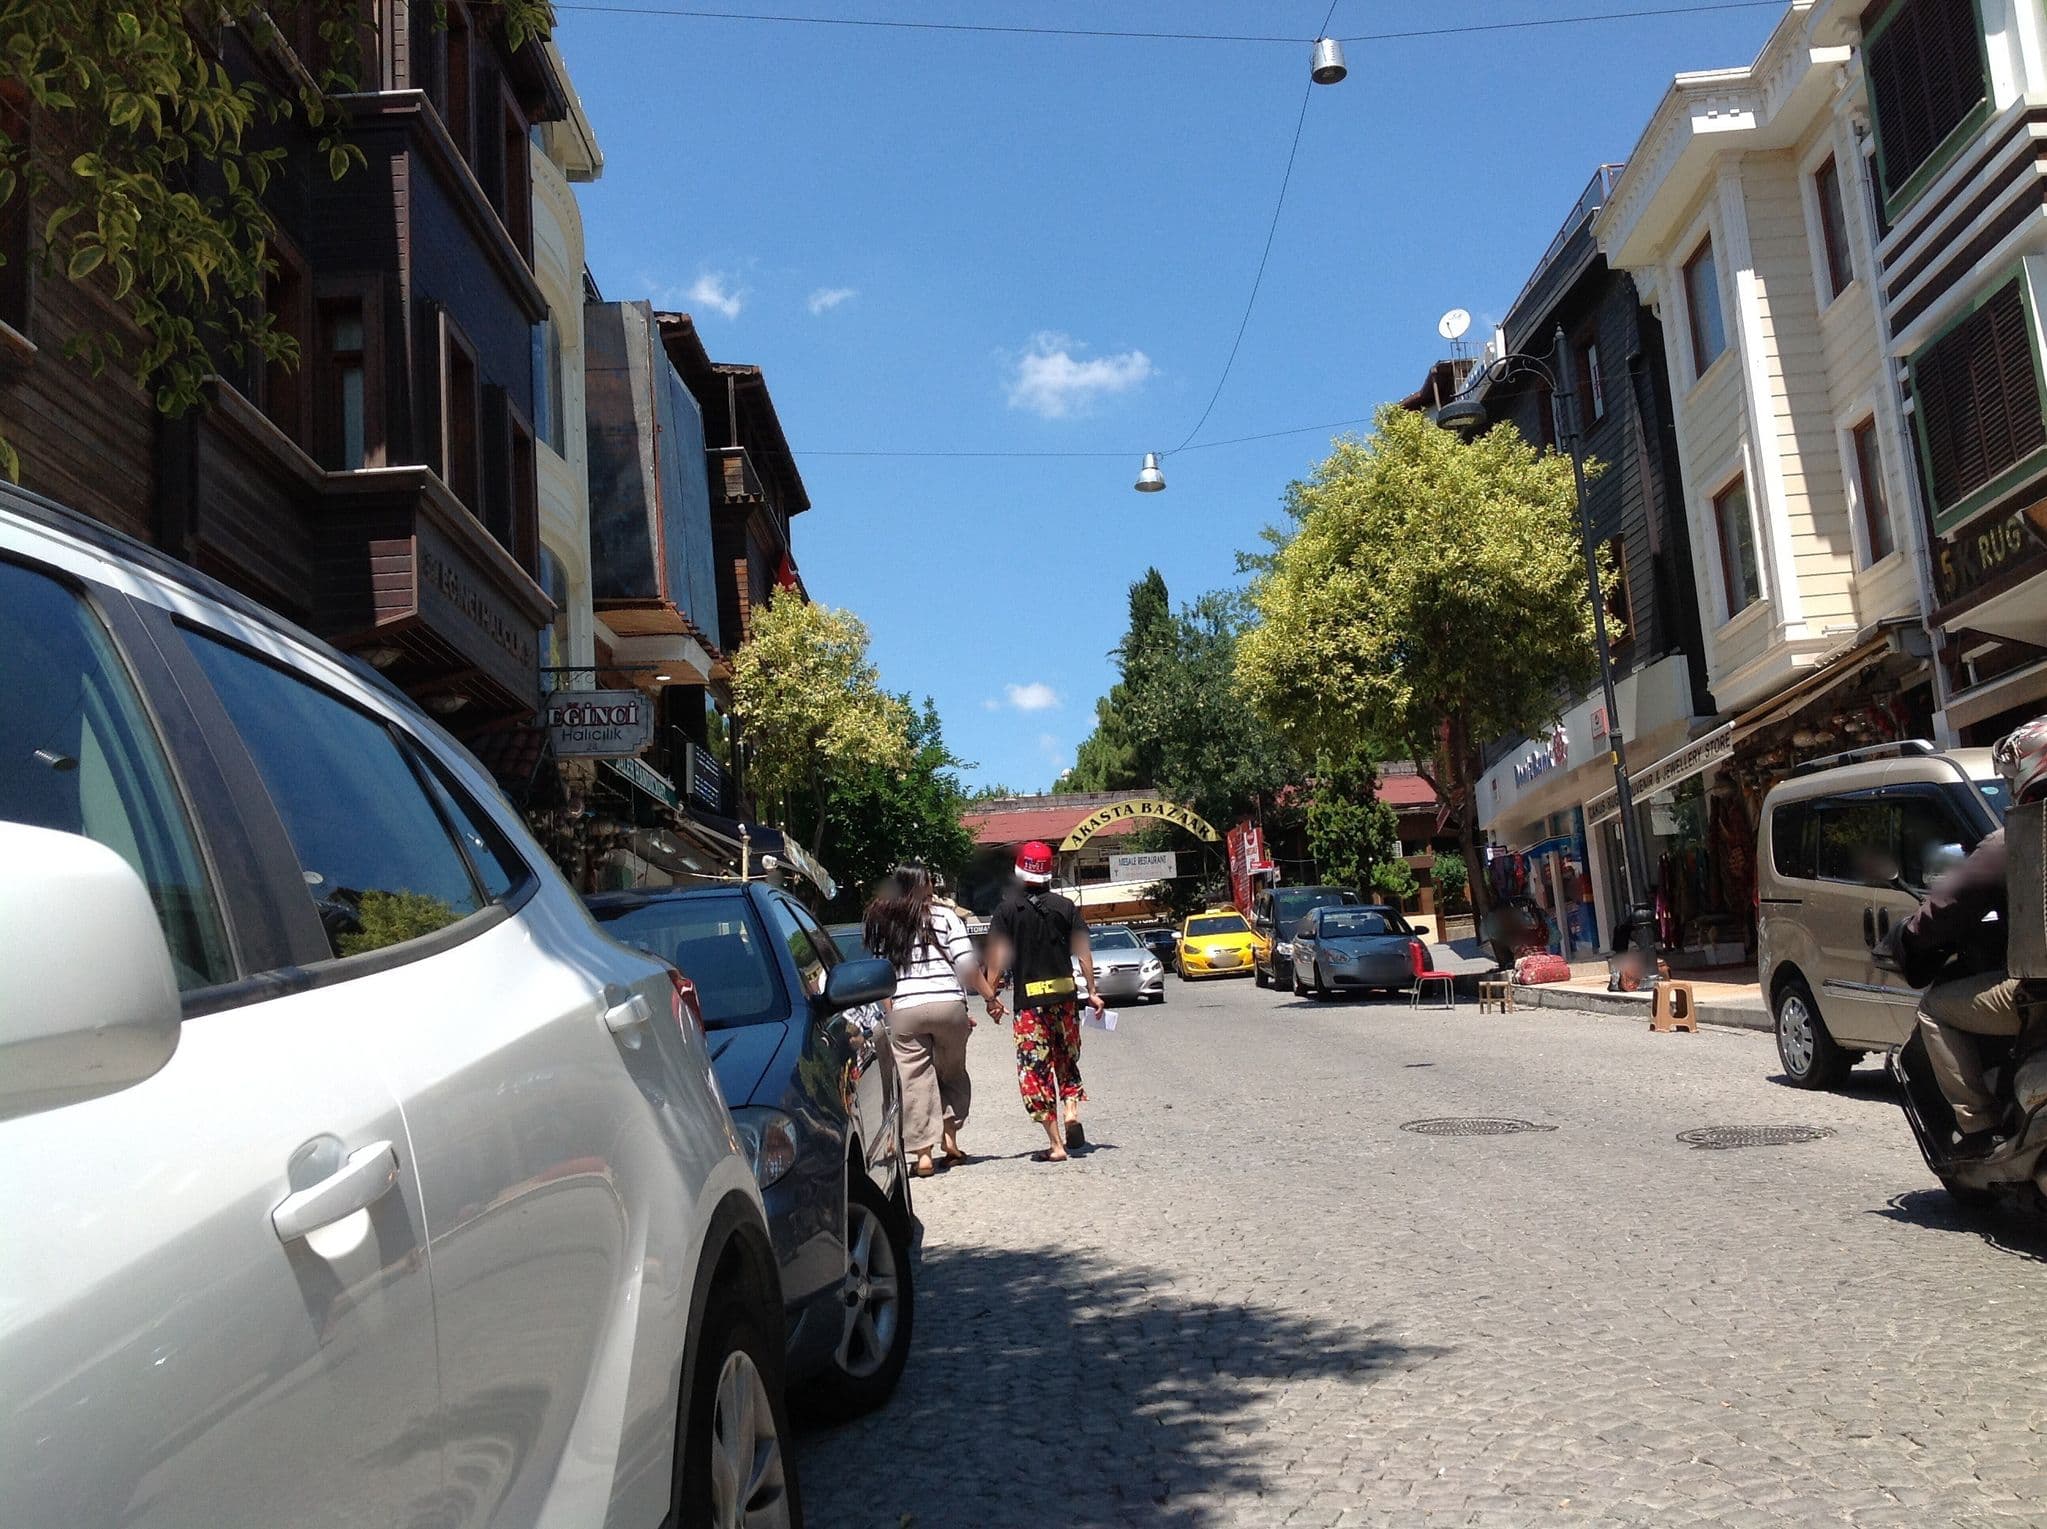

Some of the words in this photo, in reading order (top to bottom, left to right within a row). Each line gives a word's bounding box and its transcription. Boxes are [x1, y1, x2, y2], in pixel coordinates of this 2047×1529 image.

[1978, 515, 2022, 569] RUG
[547, 701, 639, 727] EĞİNCİ
[1662, 748, 1702, 782] JEWELLERY
[1705, 731, 1731, 758] STORE
[1071, 804, 1134, 847] ARASTA
[1141, 802, 1210, 839] BAZAAR
[1138, 855, 1167, 866] RESTAURANT
